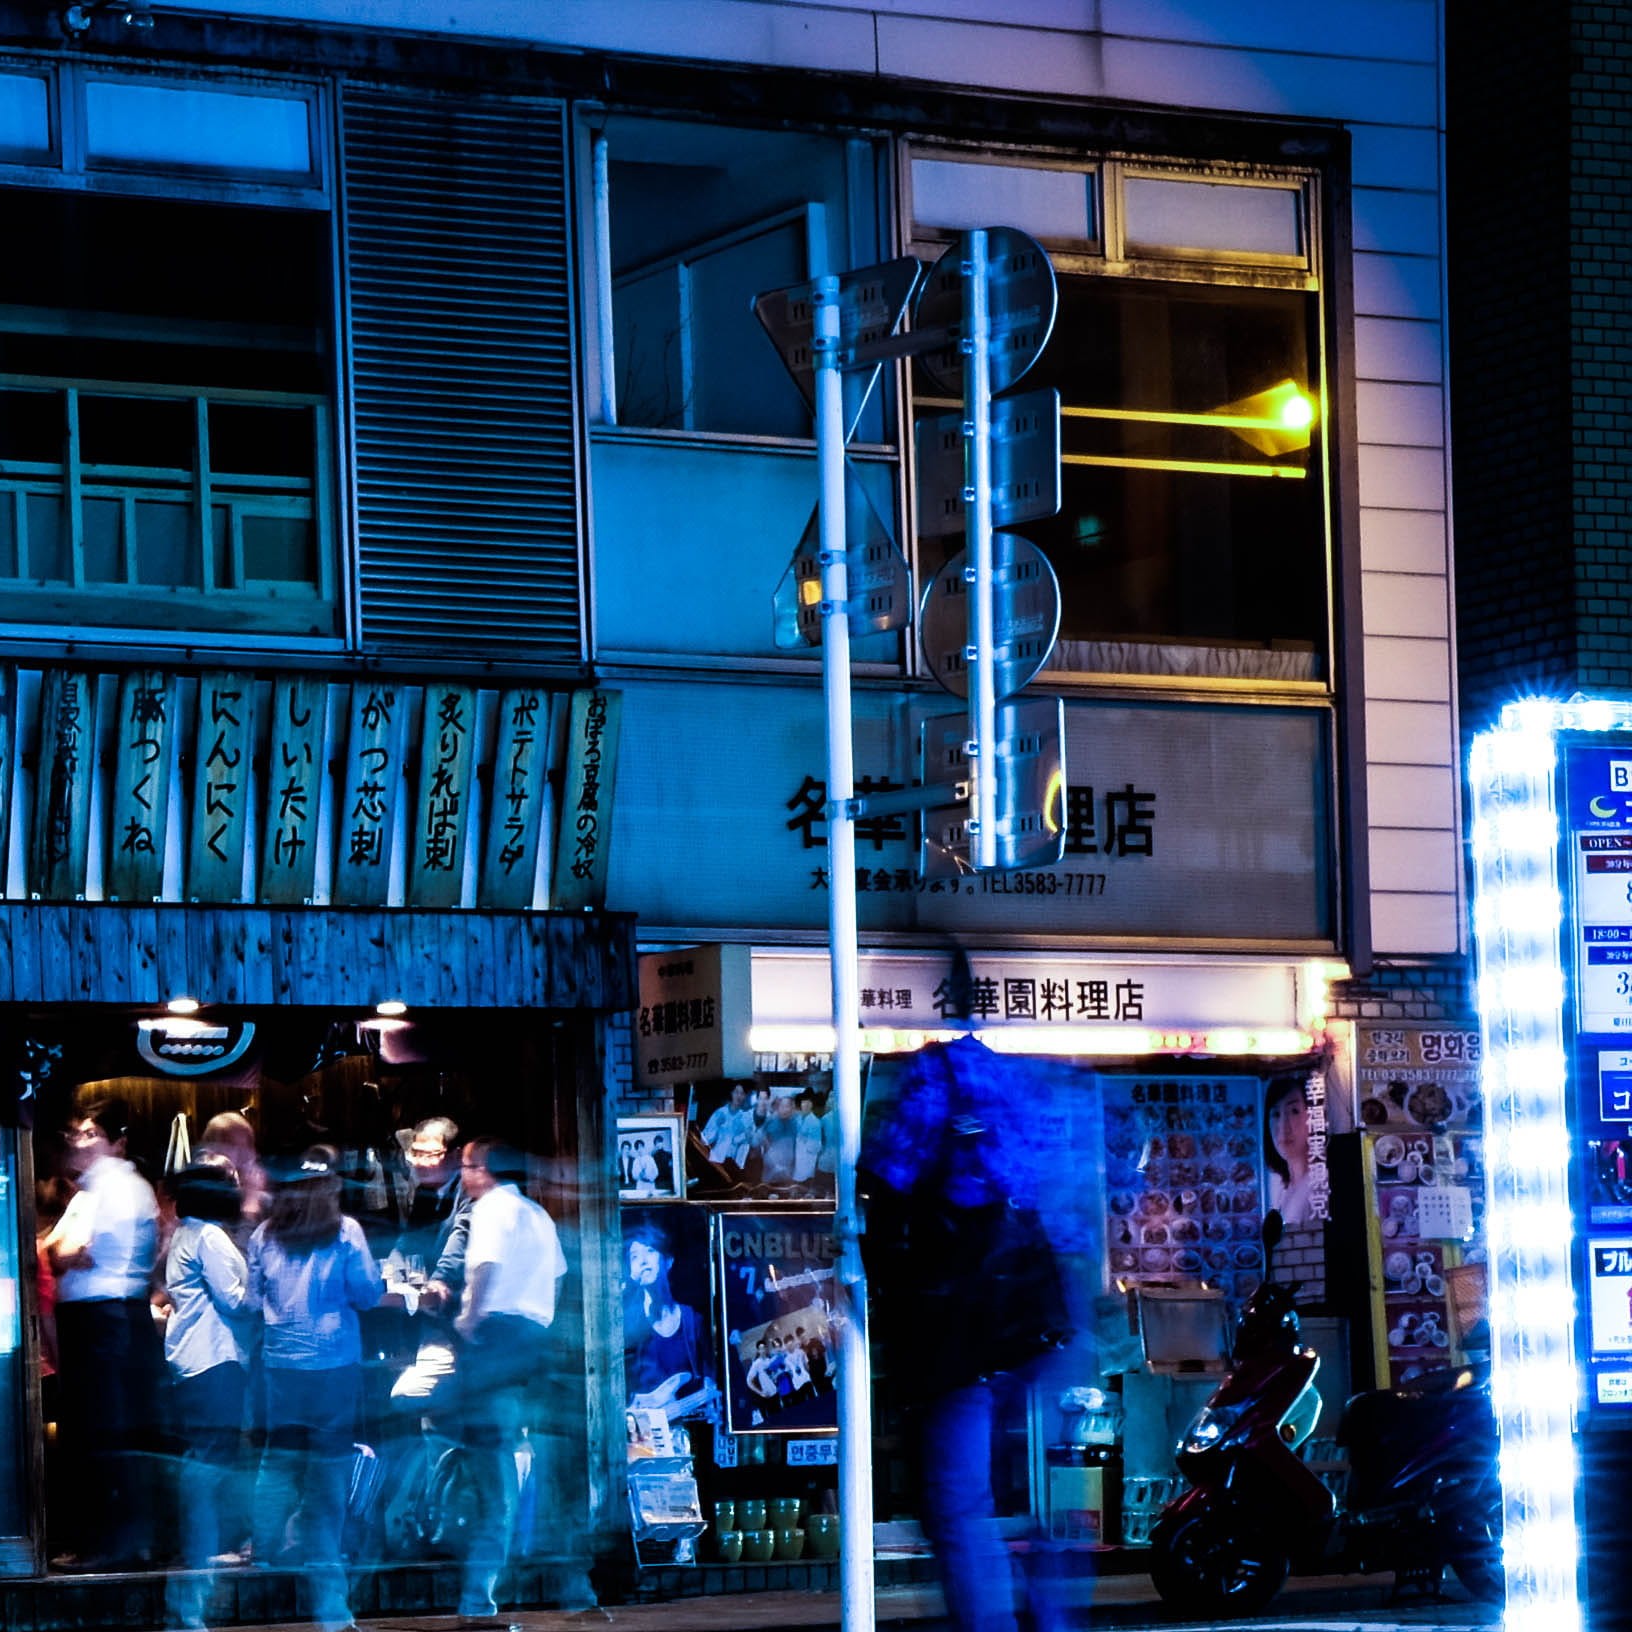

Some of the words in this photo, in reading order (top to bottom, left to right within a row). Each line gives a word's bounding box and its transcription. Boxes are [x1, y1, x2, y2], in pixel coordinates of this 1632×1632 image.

[204, 687, 244, 864] にんにく
[273, 686, 312, 868] しいたけ
[348, 691, 395, 867] がつ芯刺
[497, 693, 540, 875] ポテトサラダ
[791, 1444, 838, 1462] 연중무
